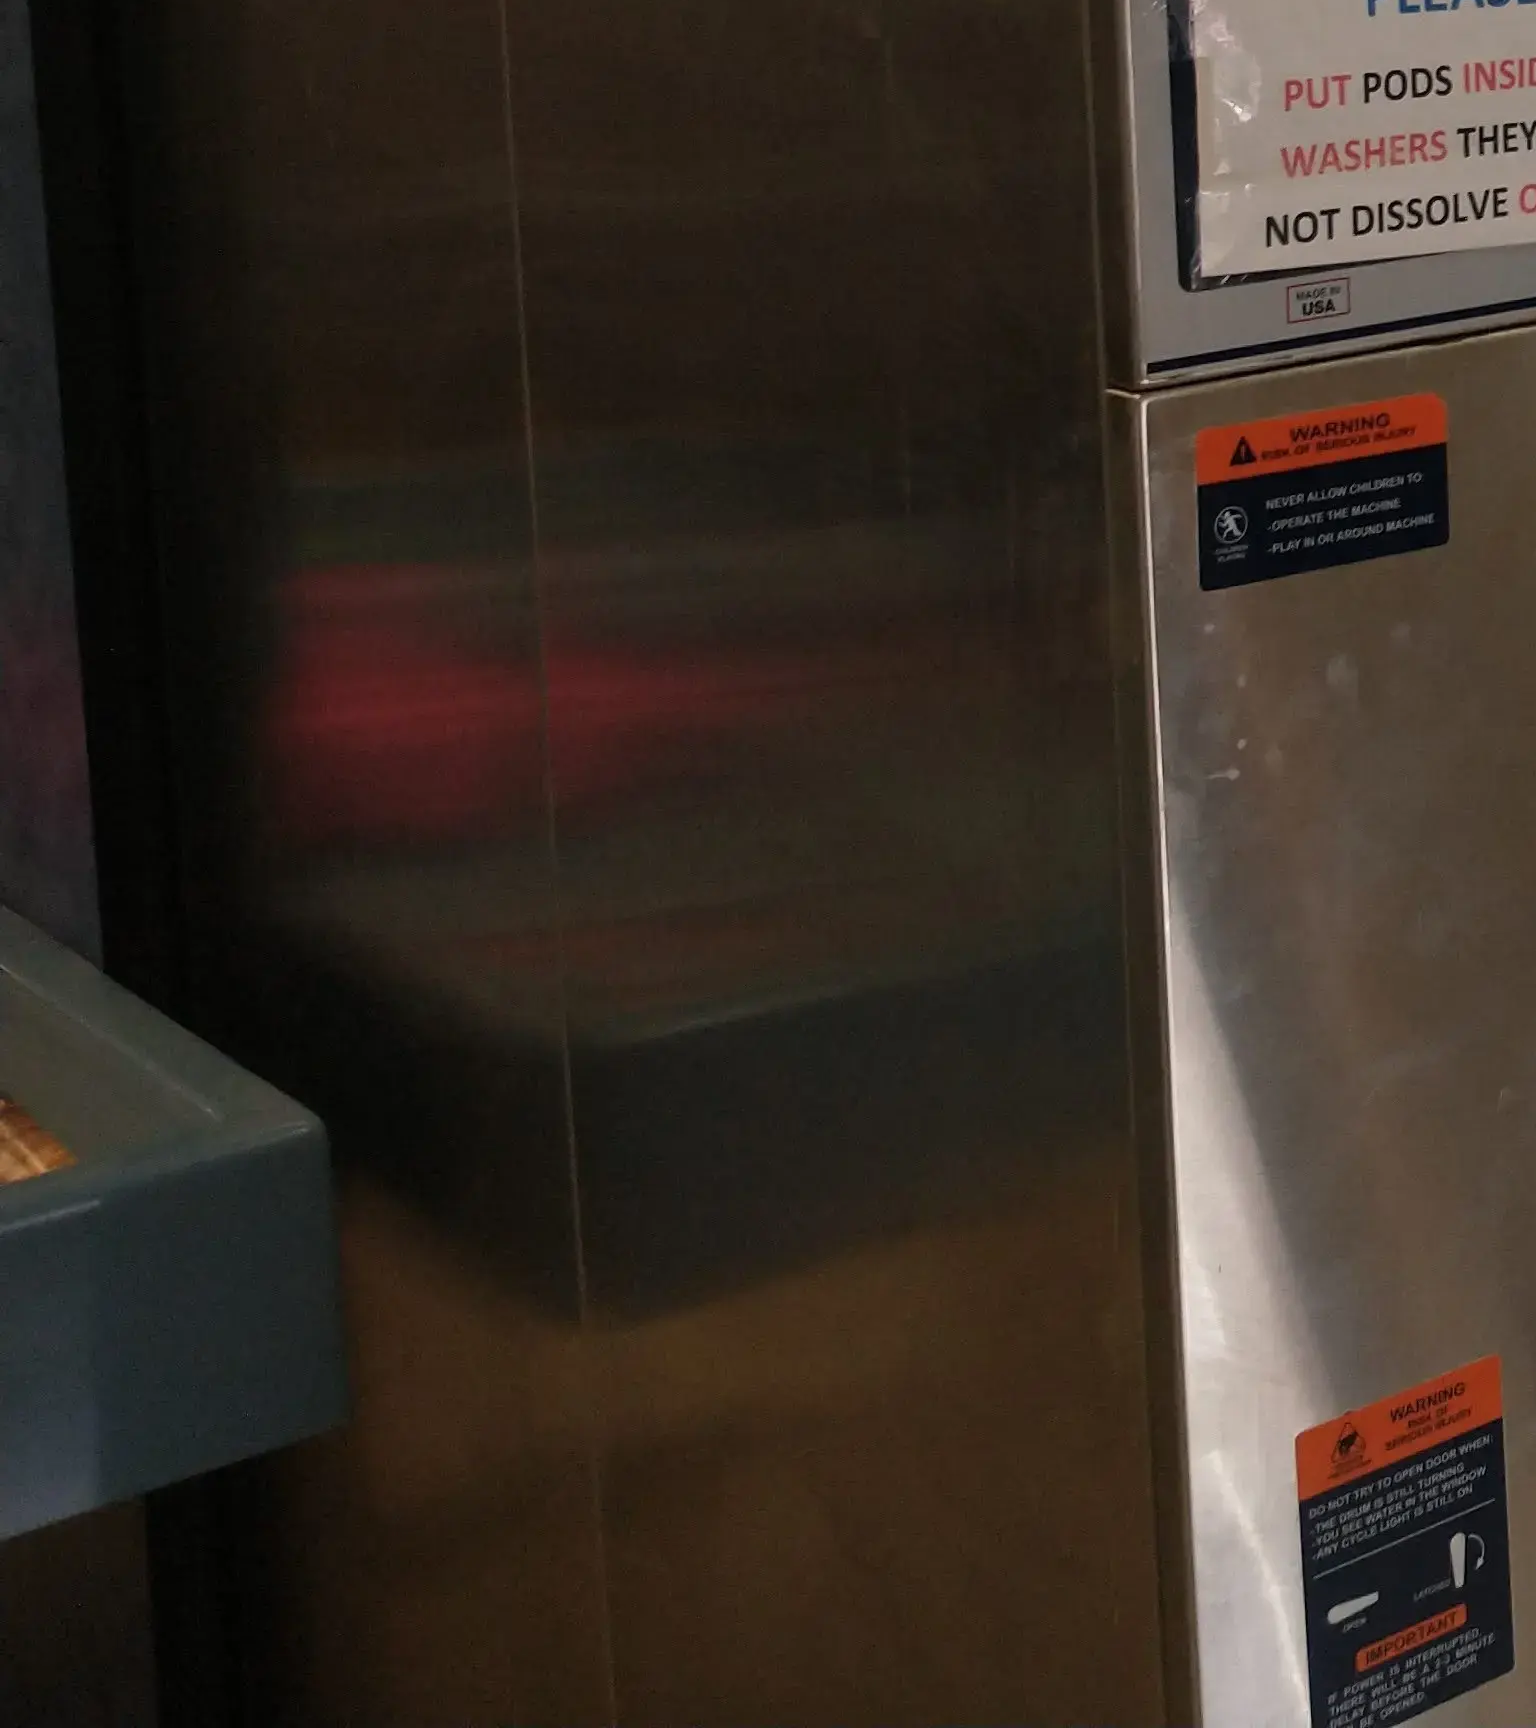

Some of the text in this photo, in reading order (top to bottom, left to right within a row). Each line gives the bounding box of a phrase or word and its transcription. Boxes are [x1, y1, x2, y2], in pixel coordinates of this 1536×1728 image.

[1284, 75, 1352, 112] PUT
[1362, 65, 1454, 104] PODS
[1280, 130, 1448, 179] WASHERS
[1265, 207, 1341, 248] NOT
[1352, 186, 1511, 237] DISSOLVE
[1302, 298, 1336, 316] USA
[1290, 412, 1391, 442] WARNING
[1266, 471, 1424, 511] NEVER ALLOW CHILDREN TO
[1327, 506, 1349, 520] THE
[1351, 497, 1402, 516] MACHINE
[1304, 534, 1316, 548] IN
[1317, 532, 1334, 545] OR
[1336, 521, 1384, 544] AROUND
[1385, 512, 1435, 532] MACHINE
[1390, 1382, 1466, 1423] WARNING
[1309, 1505, 1326, 1519] DO
[1326, 1494, 1350, 1512] NOT
[1353, 1484, 1376, 1501] TRY
[1377, 1476, 1392, 1491] TO
[1394, 1462, 1424, 1483] OPEN
[1426, 1449, 1457, 1470] DOOR
[1339, 1502, 1371, 1522] DRUM
[1373, 1496, 1384, 1508] IS
[1386, 1484, 1415, 1504] STILL
[1417, 1461, 1465, 1489] TURNING
[1342, 1520, 1364, 1535] SEE
[1366, 1502, 1402, 1525] WATER
[1404, 1496, 1416, 1508] IN
[1418, 1484, 1440, 1501] THE
[1441, 1464, 1488, 1493] WINDOW
[1341, 1526, 1377, 1548] CYCLE
[1379, 1512, 1411, 1533] LIGHT
[1413, 1505, 1425, 1518] IS
[1426, 1494, 1455, 1512] STILL
[1456, 1483, 1474, 1498] ON
[1365, 1610, 1458, 1666] IMPORTANT
[1329, 1696, 1367, 1717] THERE
[1371, 1680, 1398, 1699] WILL
[1402, 1669, 1417, 1683] BE
[1423, 1663, 1431, 1674] A
[1455, 1632, 1496, 1659] MINUTE
[1329, 1653, 1478, 1728] DELAY BEFORE THE DOOR
[1343, 1672, 1385, 1696] POWER
[1379, 1690, 1426, 1720] OPENED
